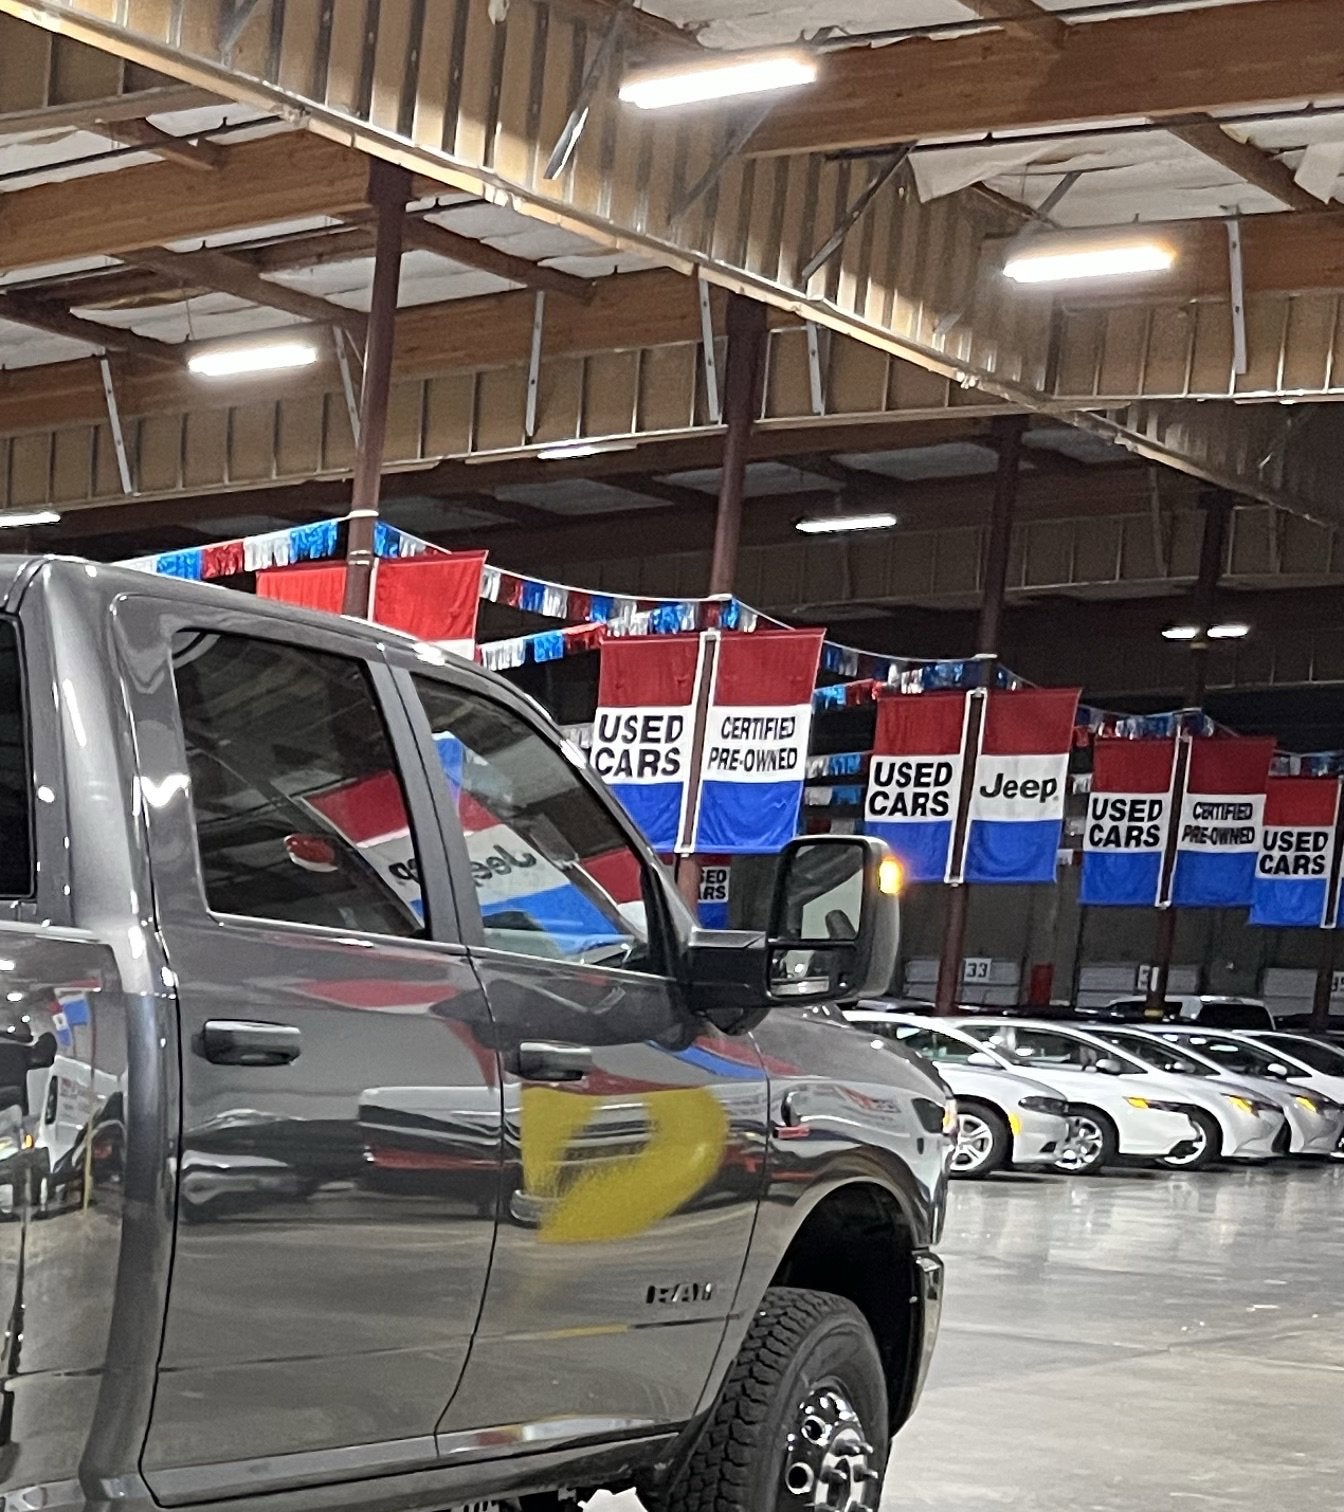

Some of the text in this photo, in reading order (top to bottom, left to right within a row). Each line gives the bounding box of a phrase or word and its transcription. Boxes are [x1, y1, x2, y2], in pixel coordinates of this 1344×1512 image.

[598, 713, 684, 744] USED
[720, 716, 796, 740] CERTIFIED
[594, 747, 682, 778] CARS
[708, 747, 798, 772] PRE-OWNED
[874, 761, 953, 788] USED
[979, 772, 1058, 803] Jeep
[868, 791, 949, 817] CARS
[1091, 798, 1163, 822] USED
[1192, 801, 1253, 821] CERTIFIED
[1089, 824, 1161, 848] CARS
[1263, 830, 1329, 852] USED
[1259, 854, 1326, 875] CARS
[966, 962, 989, 979] 33
